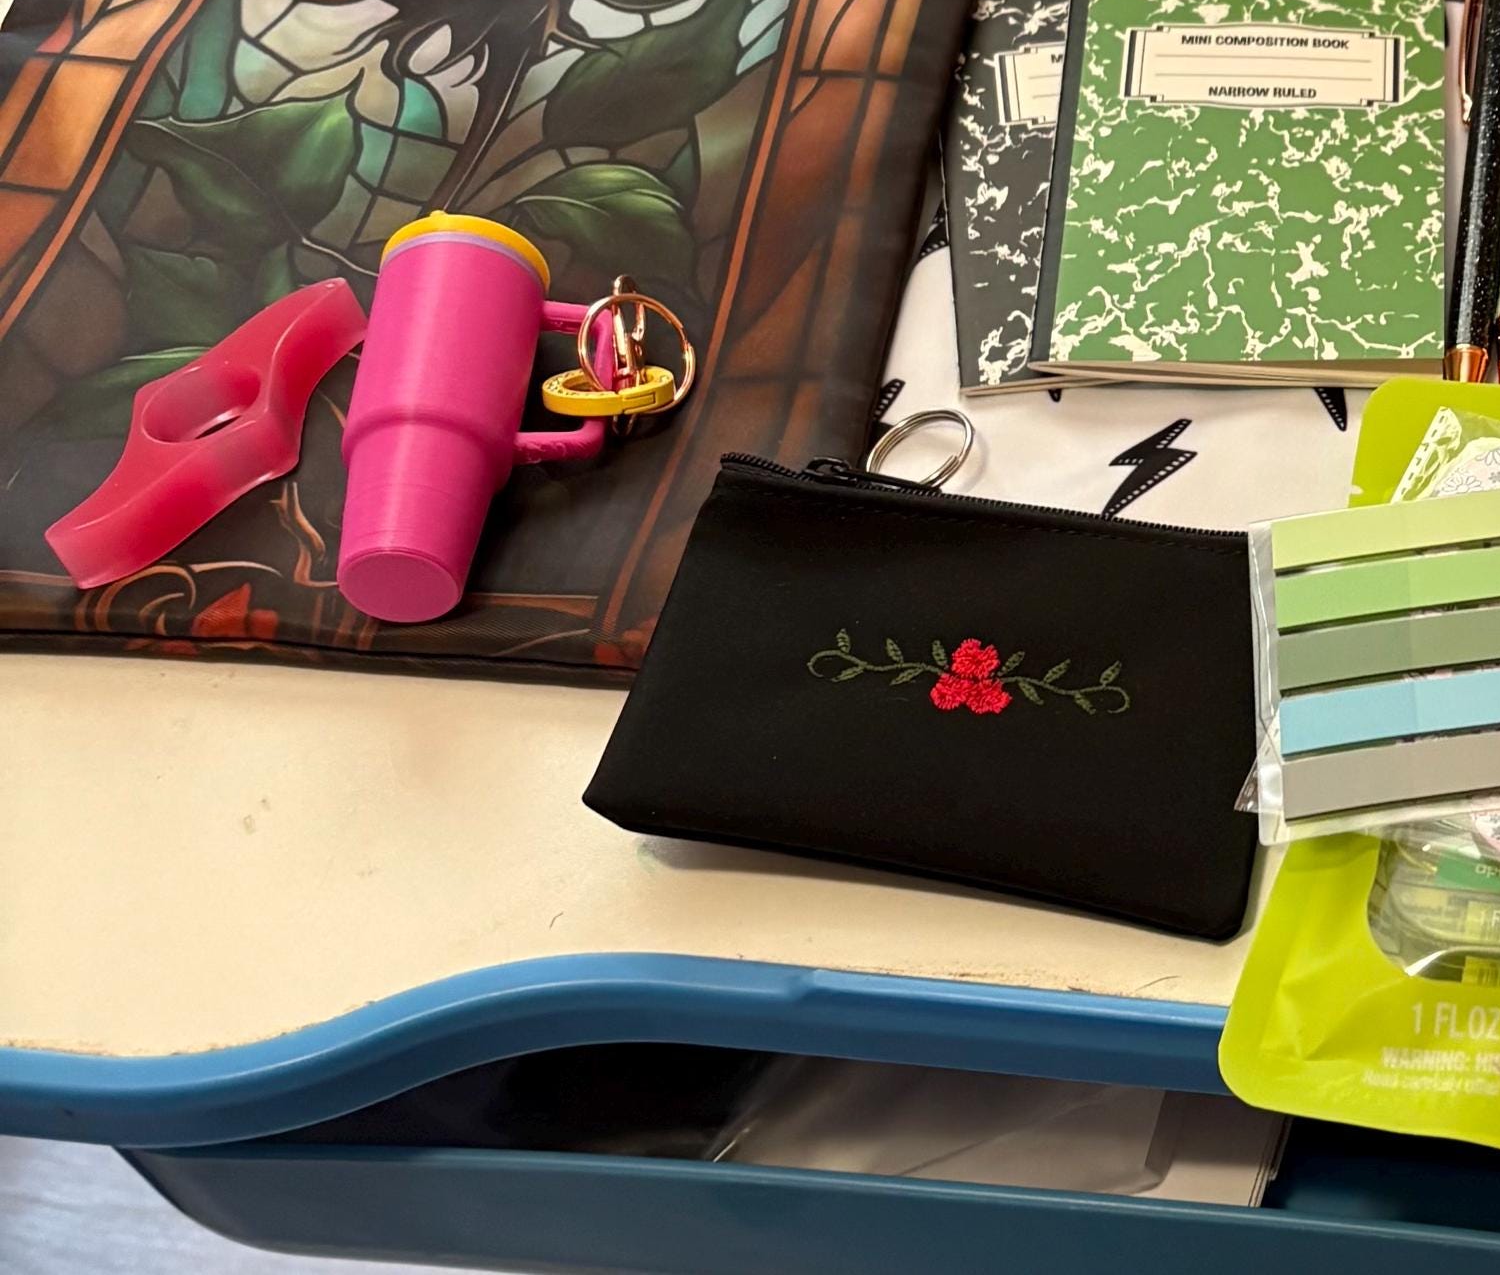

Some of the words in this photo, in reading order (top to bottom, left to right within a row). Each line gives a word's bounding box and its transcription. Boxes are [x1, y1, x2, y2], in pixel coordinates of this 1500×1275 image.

[1181, 34, 1212, 45] MINI
[1215, 35, 1309, 48] COMPOSITION
[1312, 38, 1349, 50] BOOK
[1208, 86, 1269, 98] NARROW
[1273, 86, 1317, 99] RULED
[1412, 1002, 1423, 1035] 1
